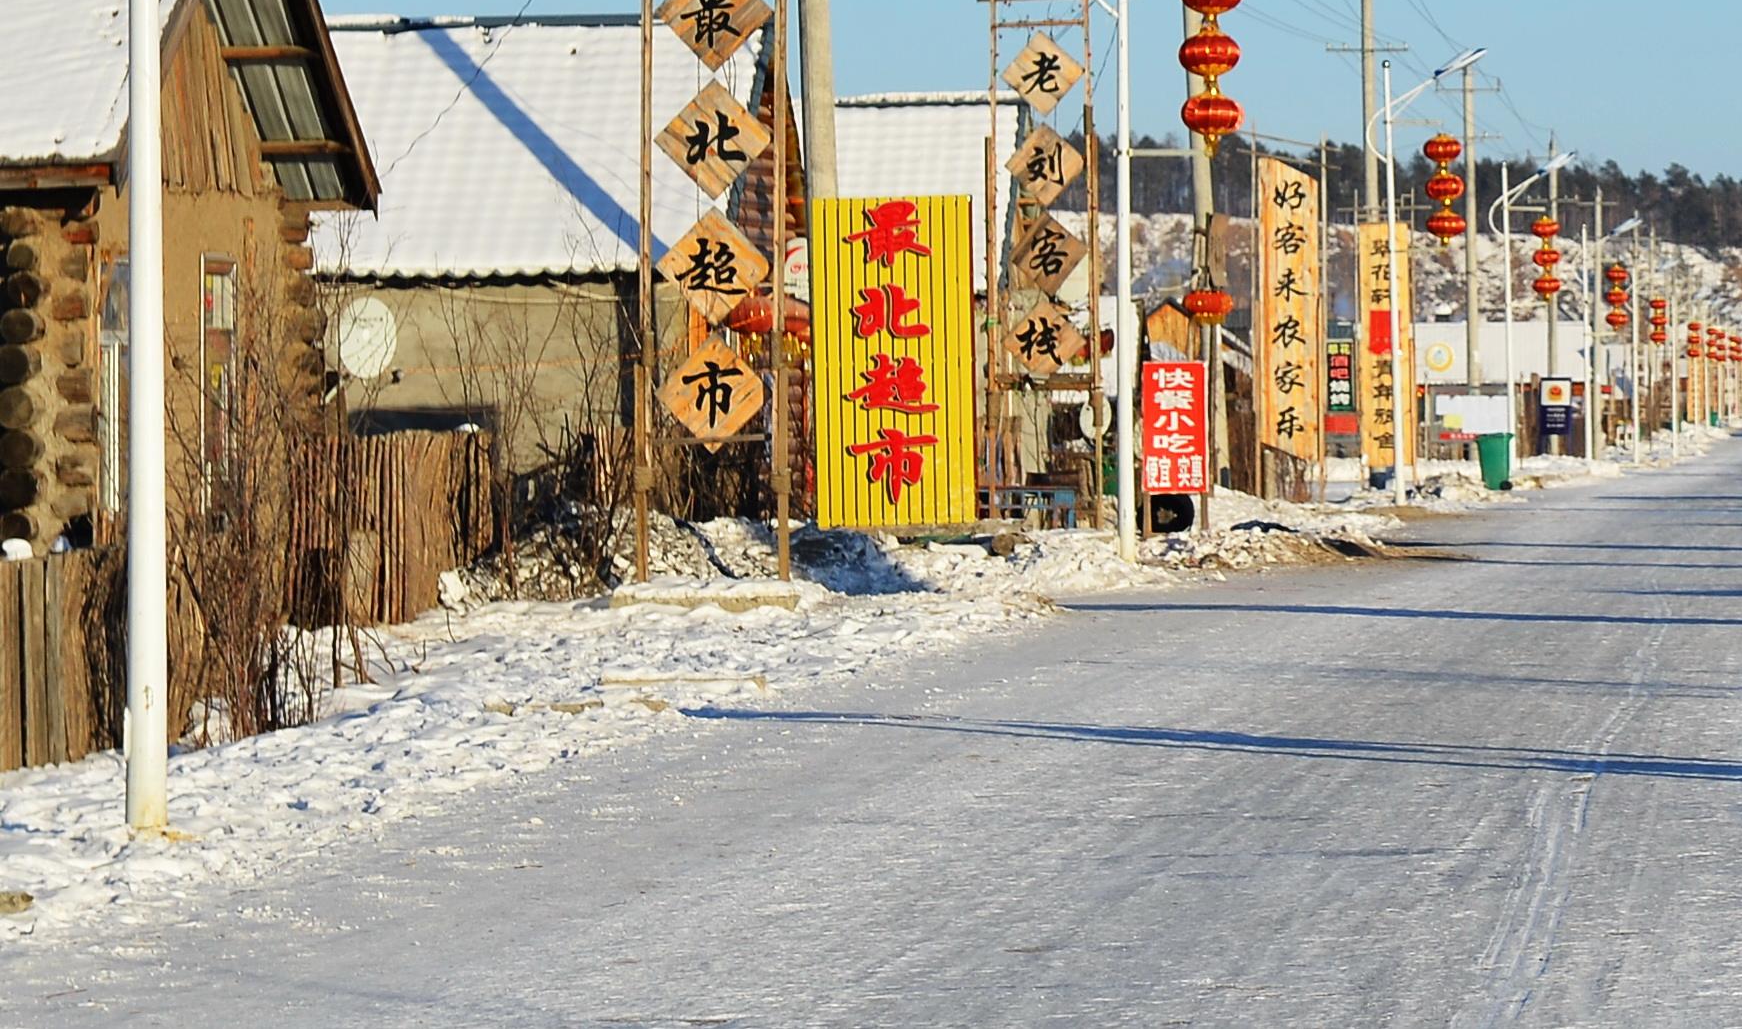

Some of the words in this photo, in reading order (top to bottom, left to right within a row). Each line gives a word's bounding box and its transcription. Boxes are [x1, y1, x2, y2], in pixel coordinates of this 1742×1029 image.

[1015, 52, 1070, 366] 老刘客栈
[1272, 180, 1308, 440] 好客来农家乐
[846, 201, 939, 503] 最北超市
[1146, 455, 1172, 488] 便宜
[1177, 454, 1203, 488] 实惠
[1152, 367, 1195, 453] 快餐小吃
